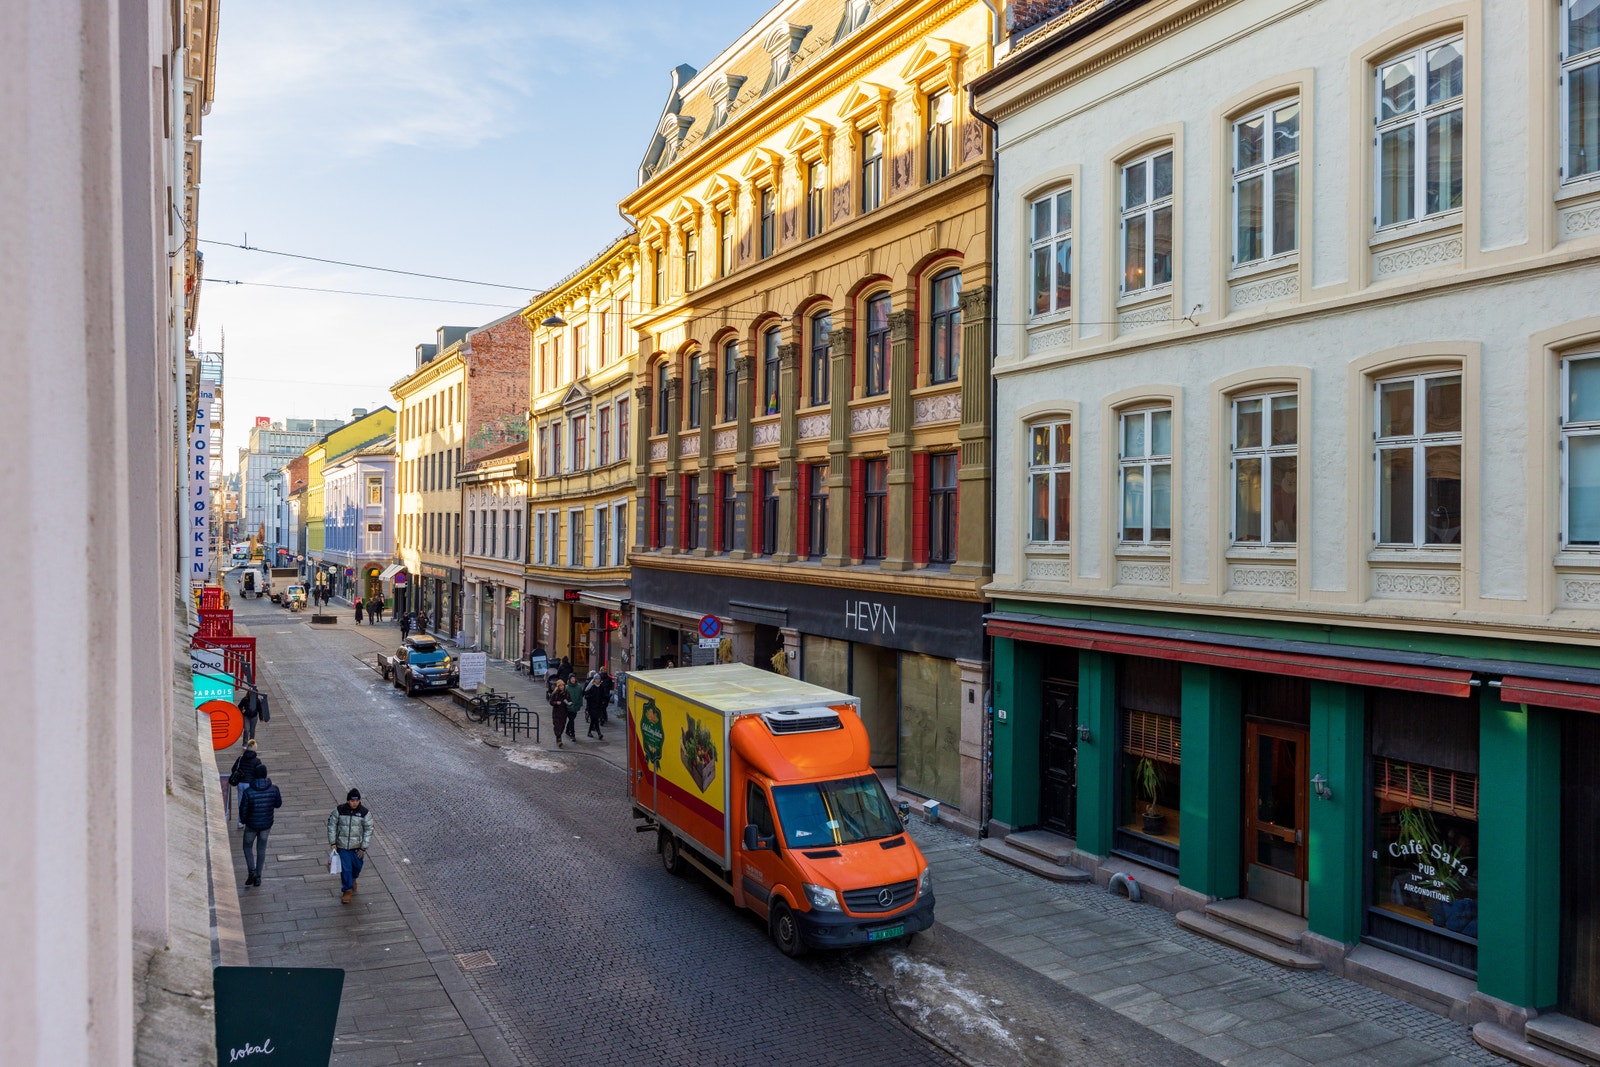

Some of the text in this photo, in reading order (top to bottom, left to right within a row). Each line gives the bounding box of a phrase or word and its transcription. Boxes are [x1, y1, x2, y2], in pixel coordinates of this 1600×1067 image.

[194, 408, 206, 573] STORKJØKKEN
[194, 688, 232, 697] PARADIS
[1389, 839, 1468, 876] Café Sara
[1418, 862, 1435, 876] PUB
[230, 1039, 275, 1063] lokal
